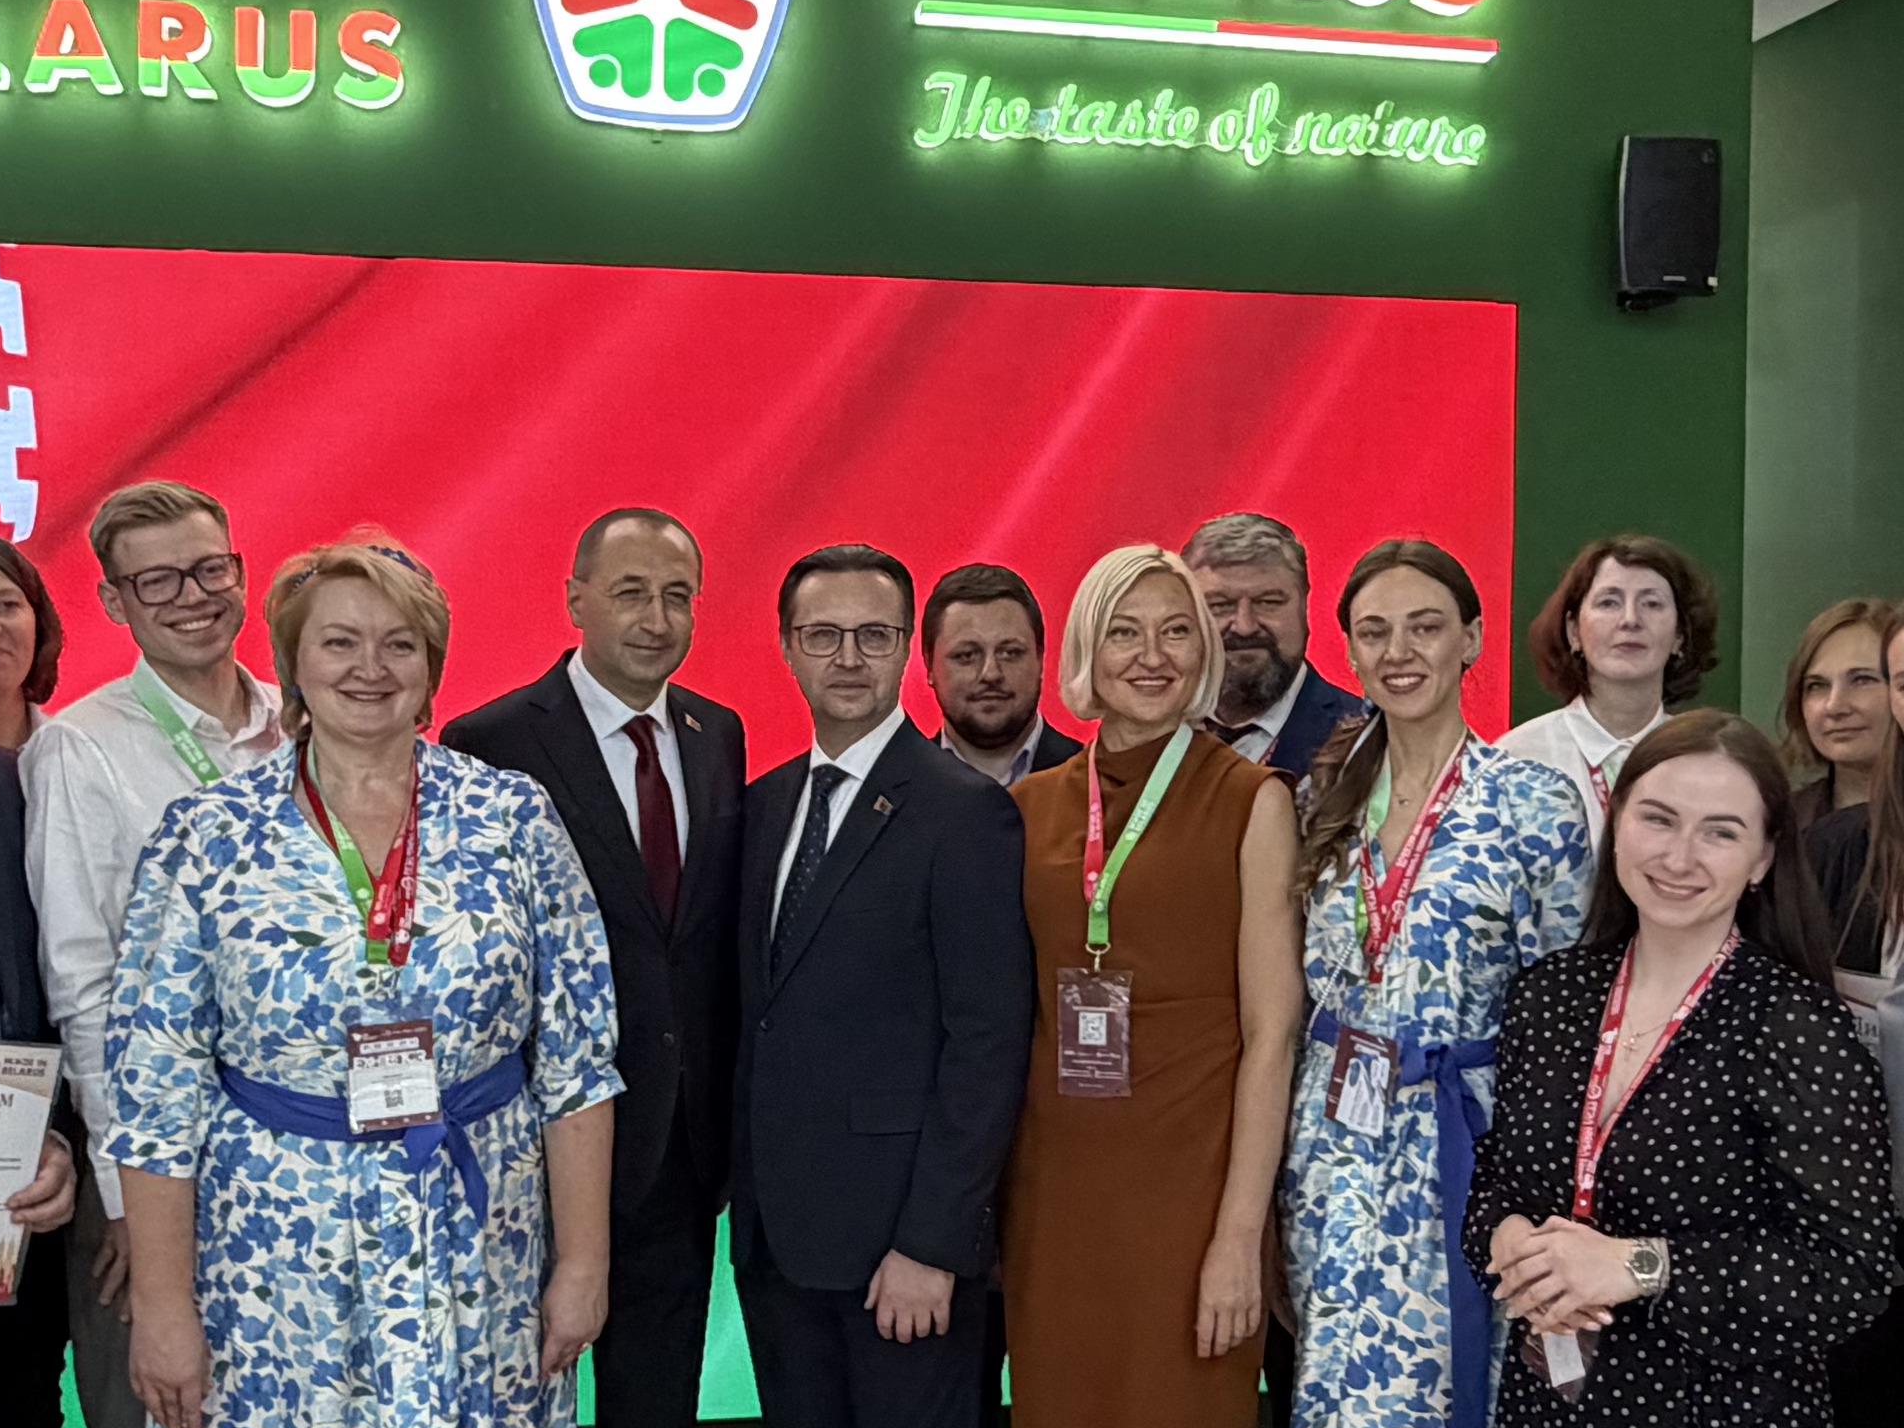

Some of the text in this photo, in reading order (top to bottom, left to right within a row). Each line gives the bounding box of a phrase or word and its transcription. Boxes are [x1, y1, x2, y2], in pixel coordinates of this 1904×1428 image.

[914, 72, 1487, 167] The taste of nature
